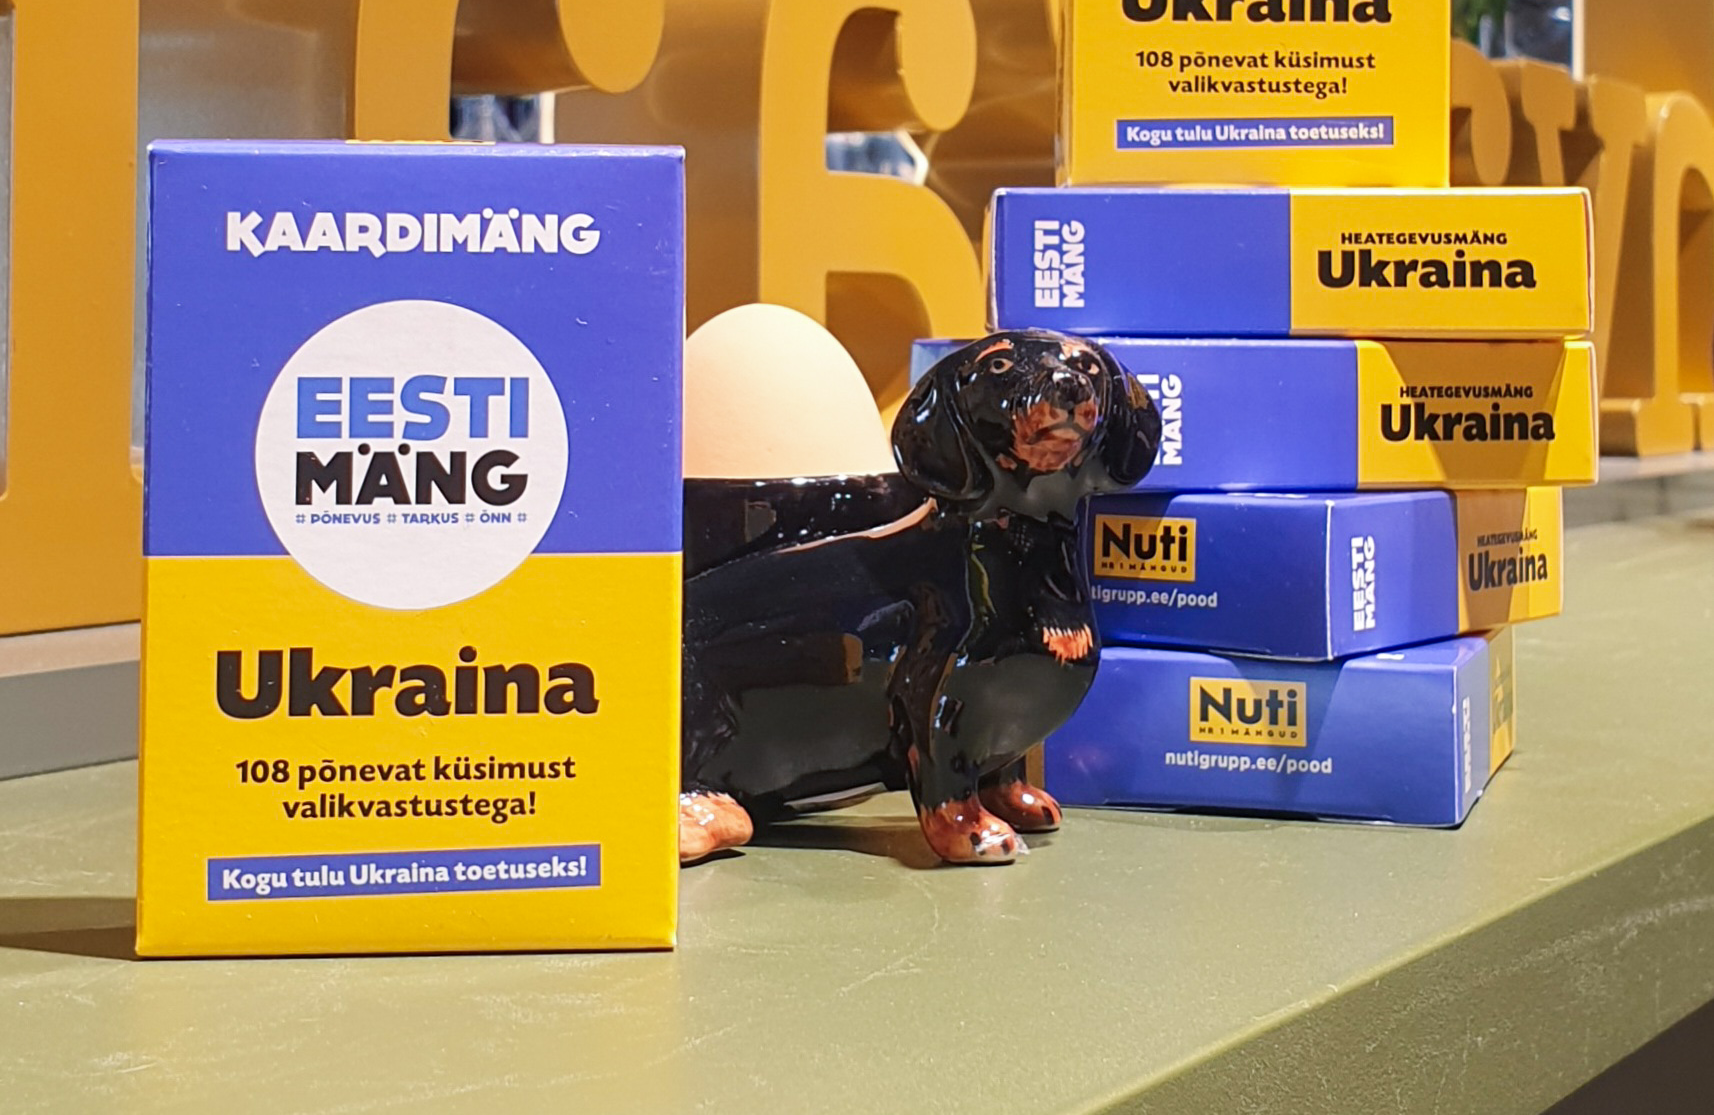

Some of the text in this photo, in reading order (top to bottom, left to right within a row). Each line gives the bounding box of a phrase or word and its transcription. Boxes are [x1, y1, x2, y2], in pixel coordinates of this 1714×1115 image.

[1135, 50, 1376, 72] 108 põnevat küsimust
[1168, 75, 1348, 99] valikvastustega!
[1126, 122, 1384, 146] Kogu tulu Ukraina toetuseks!
[226, 208, 601, 259] KAARDIMÄNG
[1340, 230, 1508, 245] HEATEGEVUSMÄNG
[1034, 220, 1060, 308] EESTI
[1060, 220, 1085, 308] MÄNG
[1317, 249, 1537, 289] Ukraina
[297, 375, 530, 441] EESTI
[1400, 384, 1534, 399] HEATEGEVUSMÄNG
[1161, 374, 1182, 466] MÄNG
[1380, 402, 1556, 442] Ukraina
[295, 442, 529, 506] MÄNG
[311, 509, 512, 525] PÕNEVUS TARKUS ÕNN
[1102, 521, 1188, 562] Nuti
[1351, 536, 1365, 631] EESTI
[1363, 535, 1376, 629] MÄNG
[1468, 546, 1548, 592] Ukraina
[1091, 585, 1218, 608] tigrupp.ee/pood
[216, 646, 600, 720] Ukraina
[1199, 685, 1298, 727] Nuti
[235, 755, 576, 790] 108 põnevat küsimust
[1165, 750, 1333, 774] nutigrupp.ee/pood
[282, 791, 537, 824] valikvastustega!
[222, 854, 588, 895] Kogu tulu Ukraina toetuseks!
